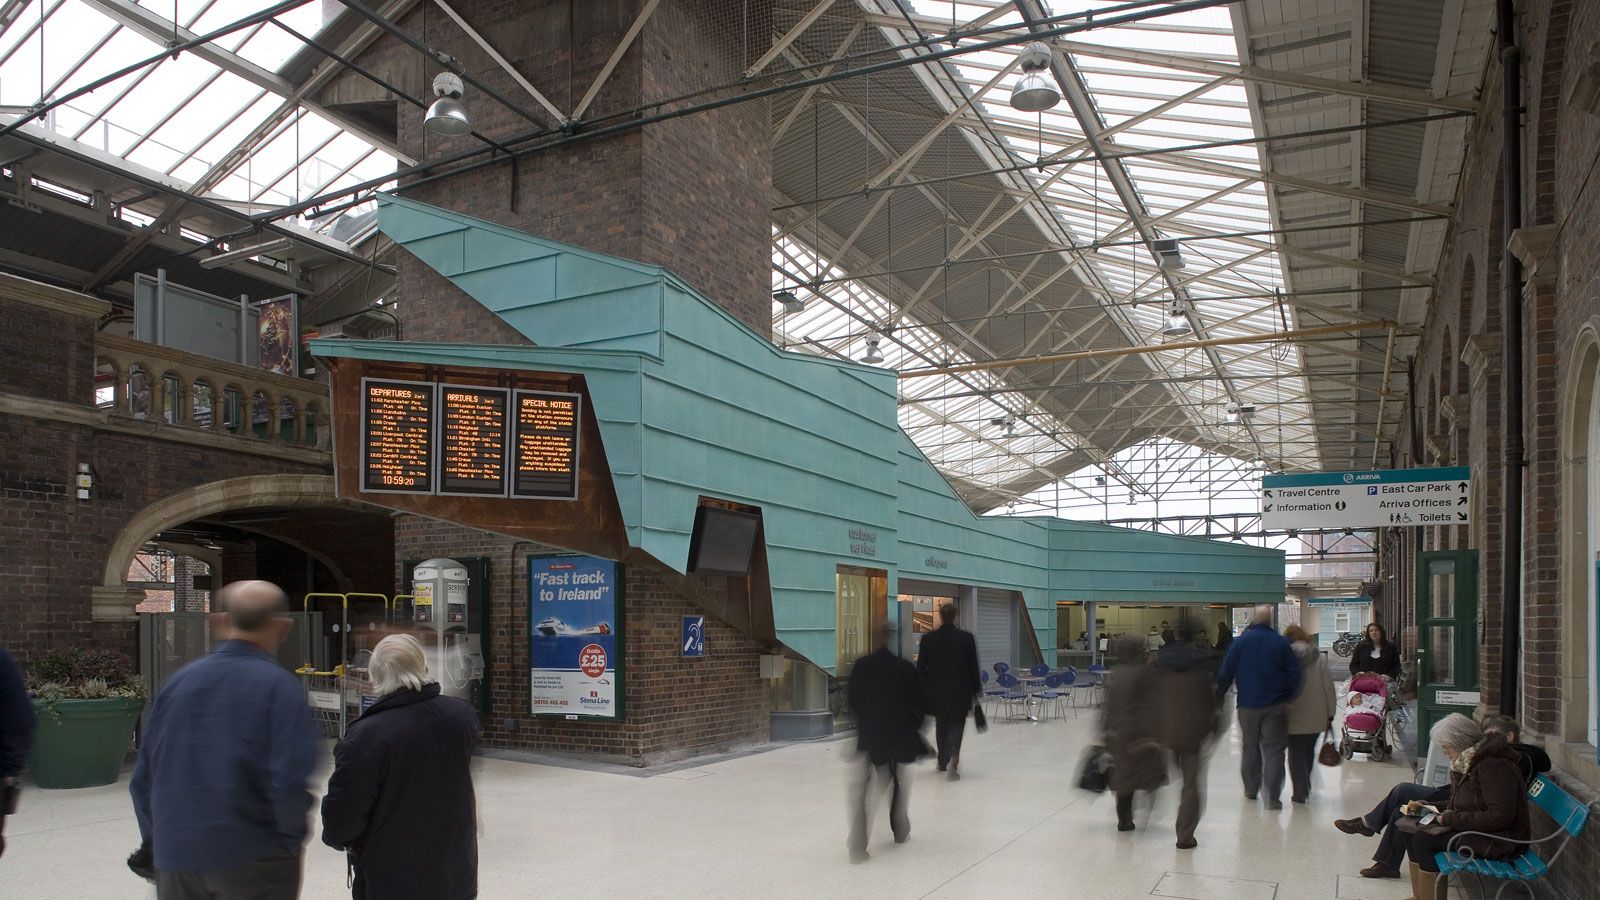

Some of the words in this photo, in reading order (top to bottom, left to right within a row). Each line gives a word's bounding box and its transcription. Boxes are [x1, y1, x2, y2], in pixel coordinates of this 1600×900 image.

[371, 388, 411, 397] DEPARTURES
[448, 394, 478, 402] ARRIVALS
[523, 399, 548, 407] SPECIAL
[1278, 489, 1308, 497] Travel
[1277, 503, 1331, 512] Information
[1380, 500, 1409, 509] Arriva
[1413, 499, 1451, 507] Offices
[572, 571, 605, 584] track
[540, 589, 554, 601] to
[582, 655, 604, 667] £25
